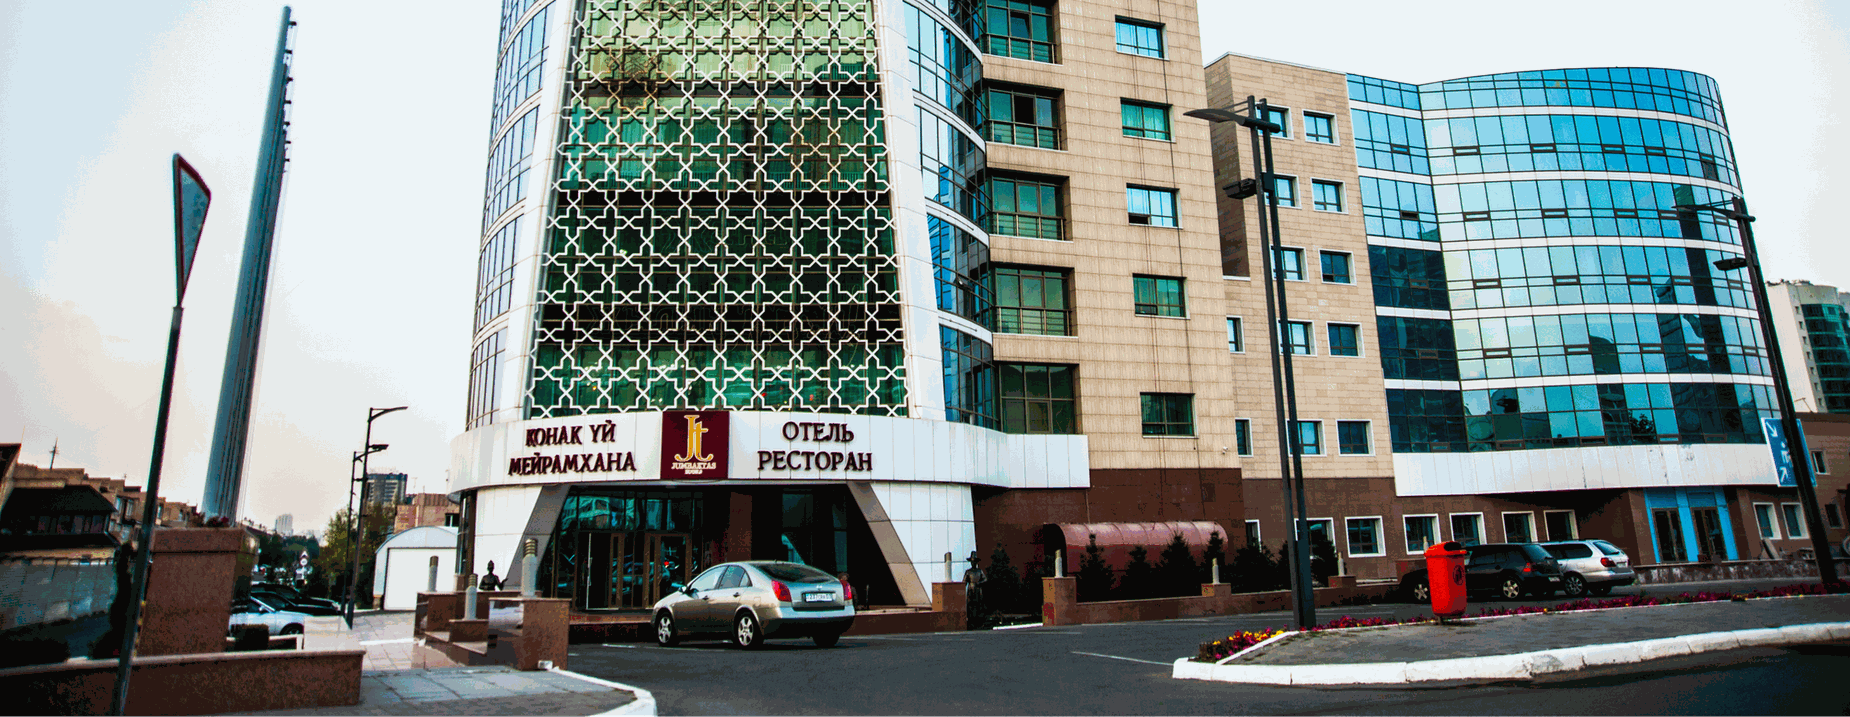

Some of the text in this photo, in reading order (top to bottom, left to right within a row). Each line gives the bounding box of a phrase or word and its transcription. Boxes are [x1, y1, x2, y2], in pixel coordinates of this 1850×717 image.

[782, 421, 855, 443] ОТЕЛЬ
[508, 451, 637, 476] МЕЙРАМХАНА
[757, 450, 873, 472] РЕСТОРАН
